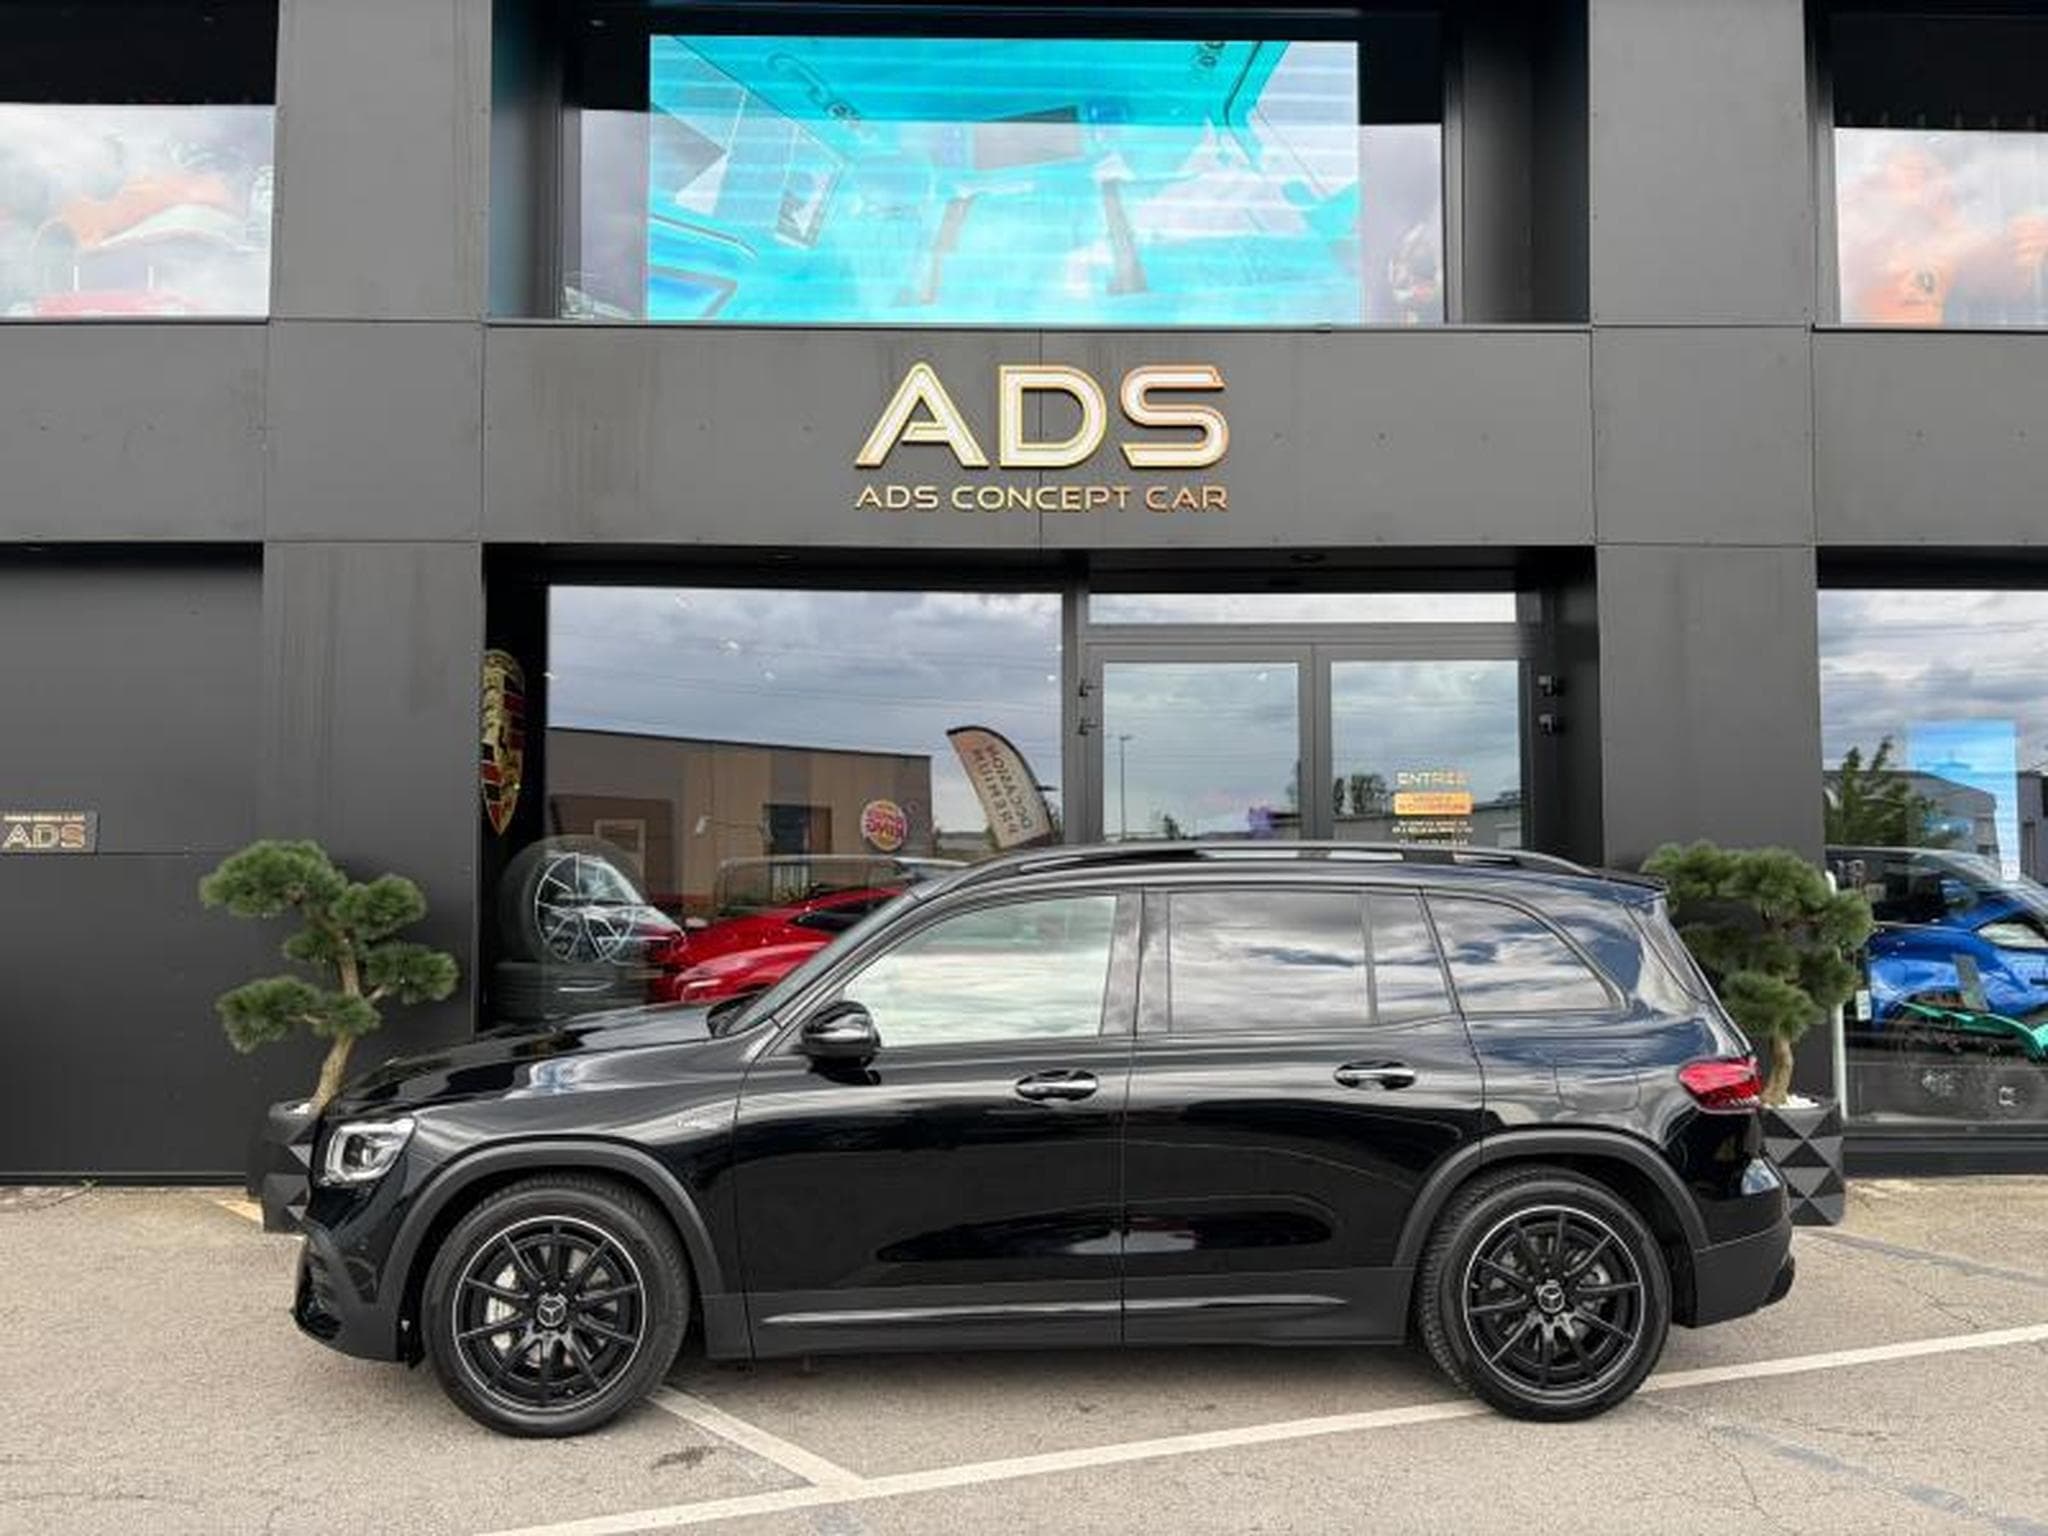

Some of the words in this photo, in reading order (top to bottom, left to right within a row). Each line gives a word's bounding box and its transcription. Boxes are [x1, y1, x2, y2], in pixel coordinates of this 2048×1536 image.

[855, 361, 1230, 469] ADS
[854, 485, 939, 510] ADS
[951, 485, 1132, 511] CONCEPT
[1144, 485, 1229, 511] CAR
[2, 823, 86, 849] ADS
